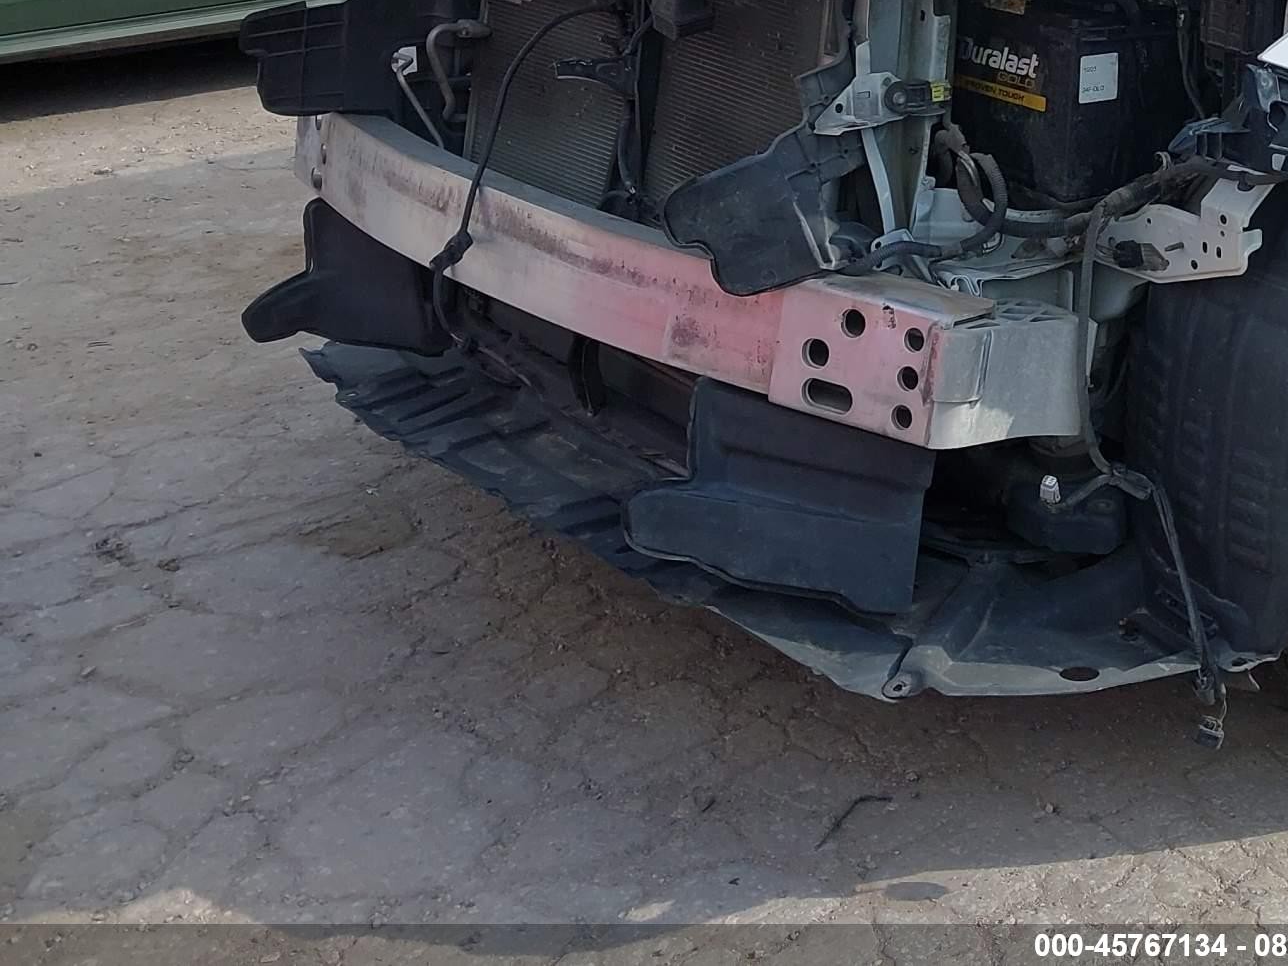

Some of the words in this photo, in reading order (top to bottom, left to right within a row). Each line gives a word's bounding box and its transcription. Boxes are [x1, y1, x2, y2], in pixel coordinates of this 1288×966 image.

[959, 37, 1040, 79] Duralast
[996, 71, 1036, 88] GOLD
[998, 87, 1025, 103] TOUGH
